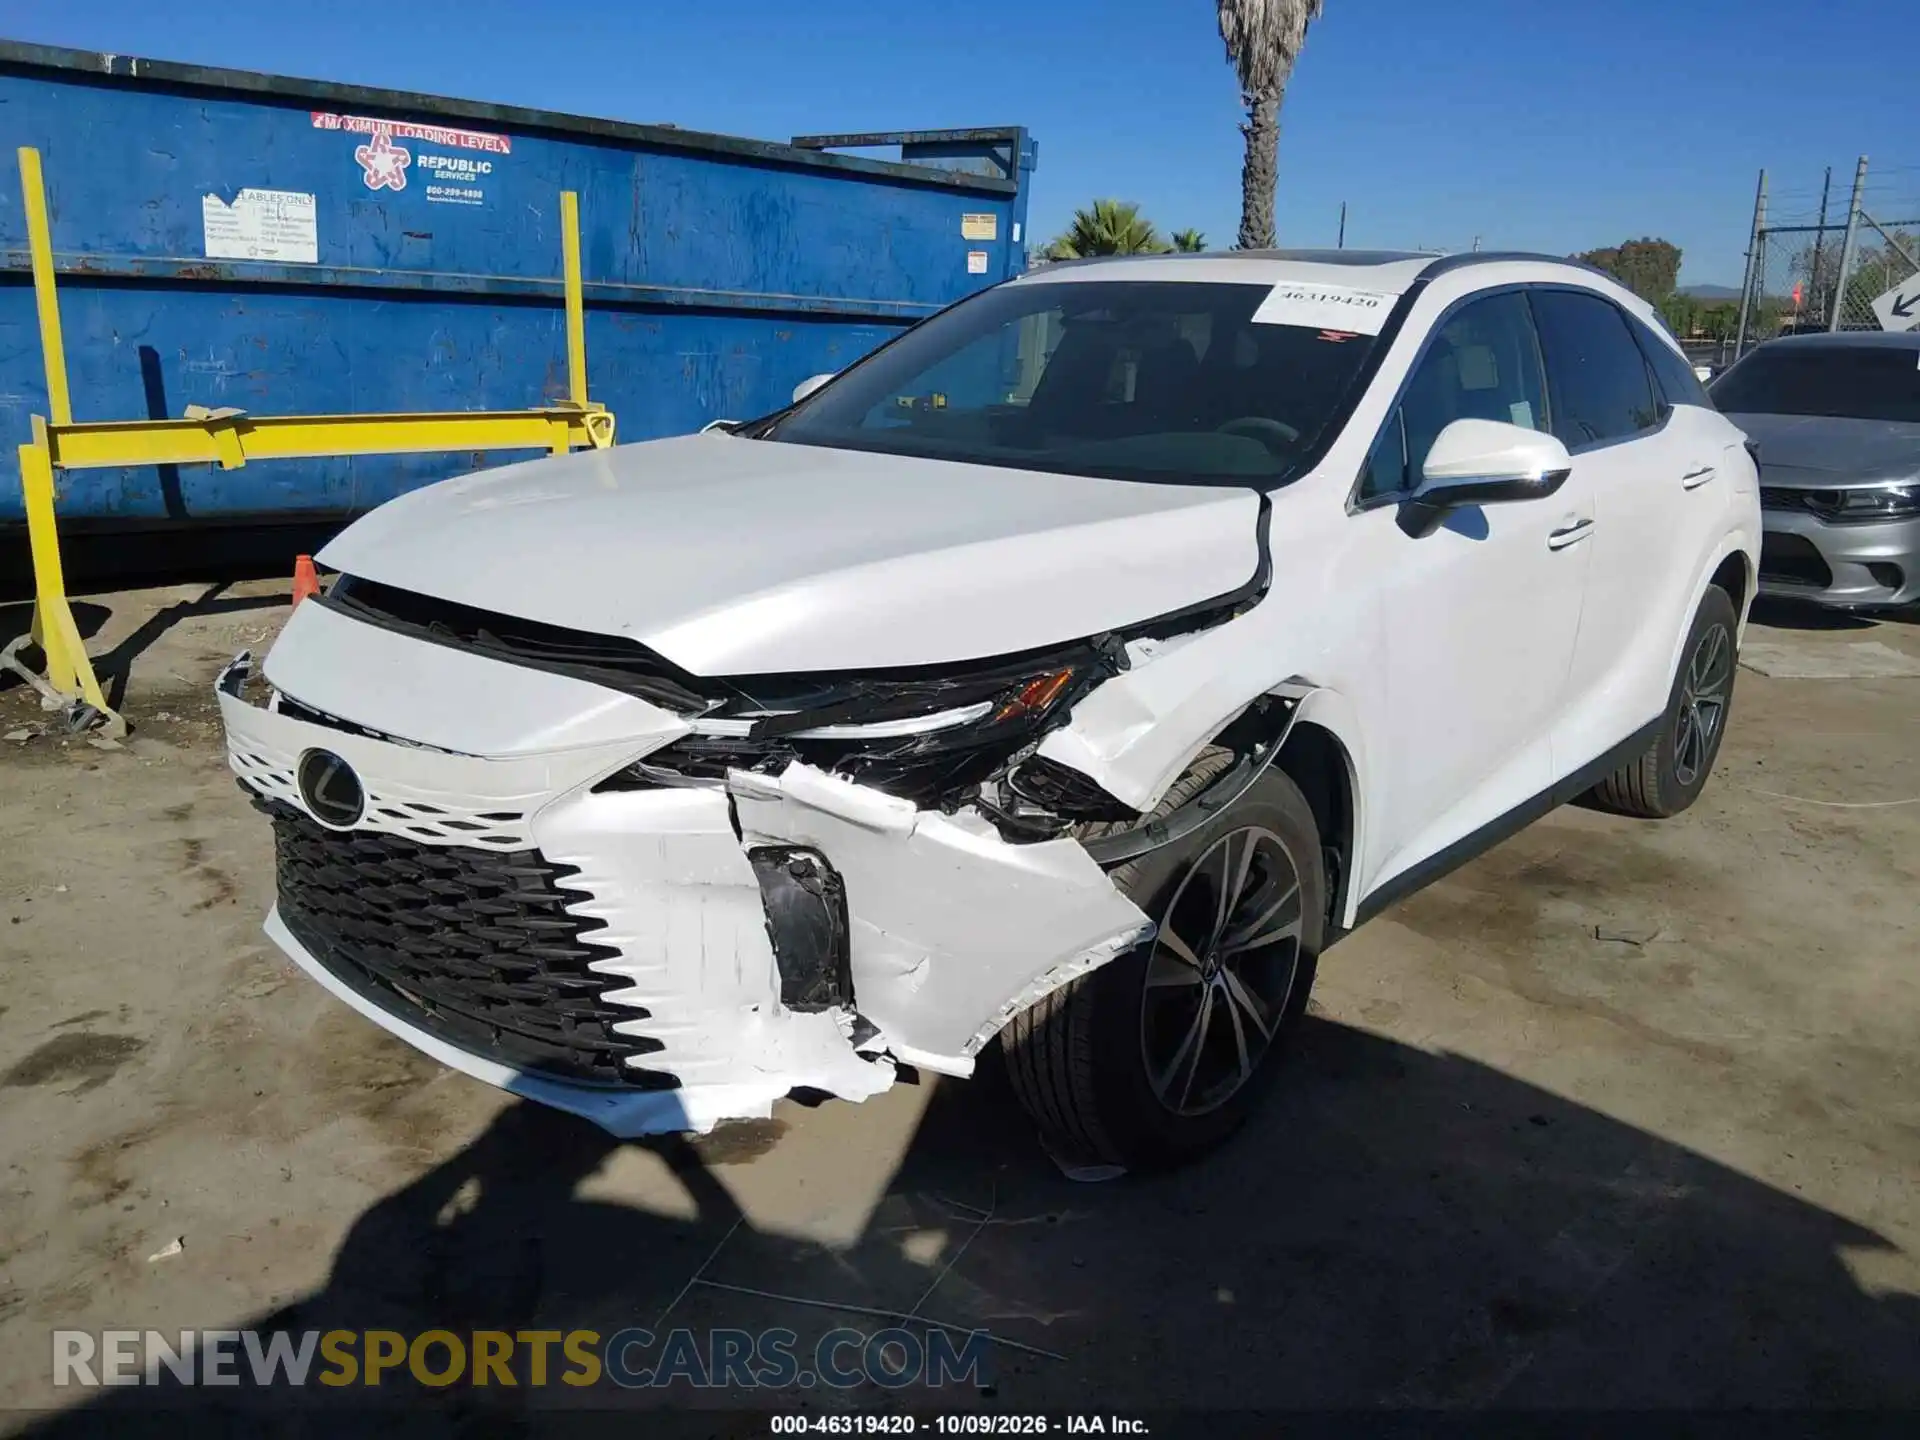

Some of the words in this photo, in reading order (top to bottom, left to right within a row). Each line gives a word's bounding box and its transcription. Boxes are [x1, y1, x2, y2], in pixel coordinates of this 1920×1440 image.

[396, 125, 457, 145] LOADING
[461, 136, 500, 152] LEVEL
[417, 155, 492, 174] REPUBLIC
[434, 170, 476, 181] SERVICES
[1280, 291, 1378, 308] 46319420
